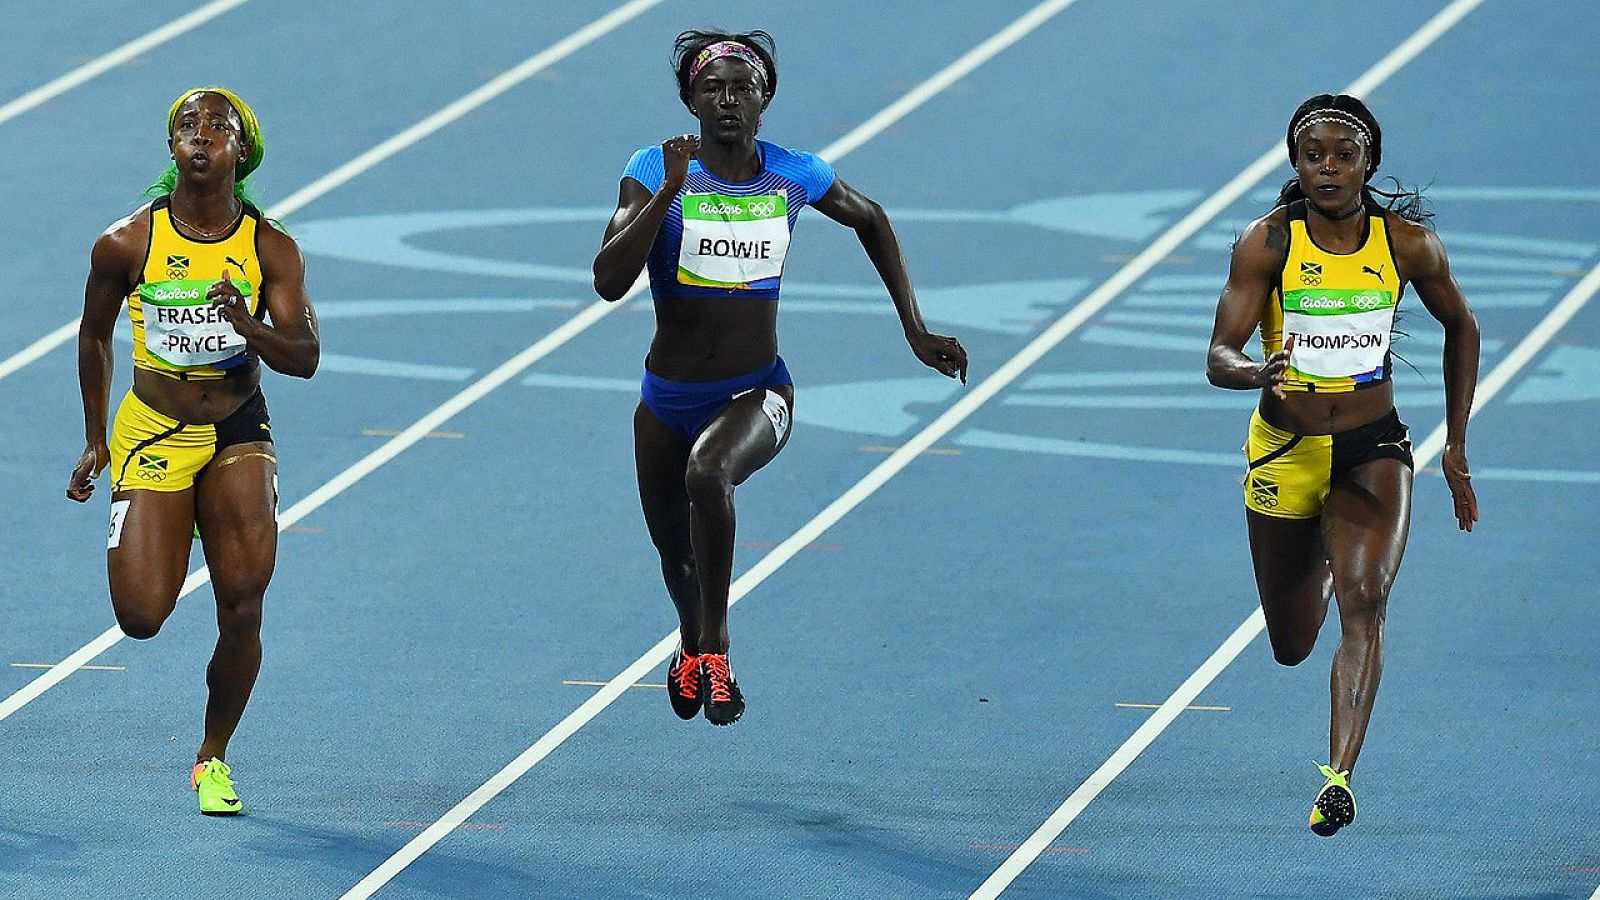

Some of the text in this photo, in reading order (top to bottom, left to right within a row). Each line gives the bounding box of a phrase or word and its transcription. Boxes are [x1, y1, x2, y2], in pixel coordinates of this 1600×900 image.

[699, 202, 742, 214] Rio2016
[699, 238, 771, 259] BOWIE
[155, 287, 199, 300] Rio2016
[1300, 295, 1346, 309] Rio2016
[162, 334, 228, 353] -PRYCE
[1288, 331, 1383, 349] THOMPSON
